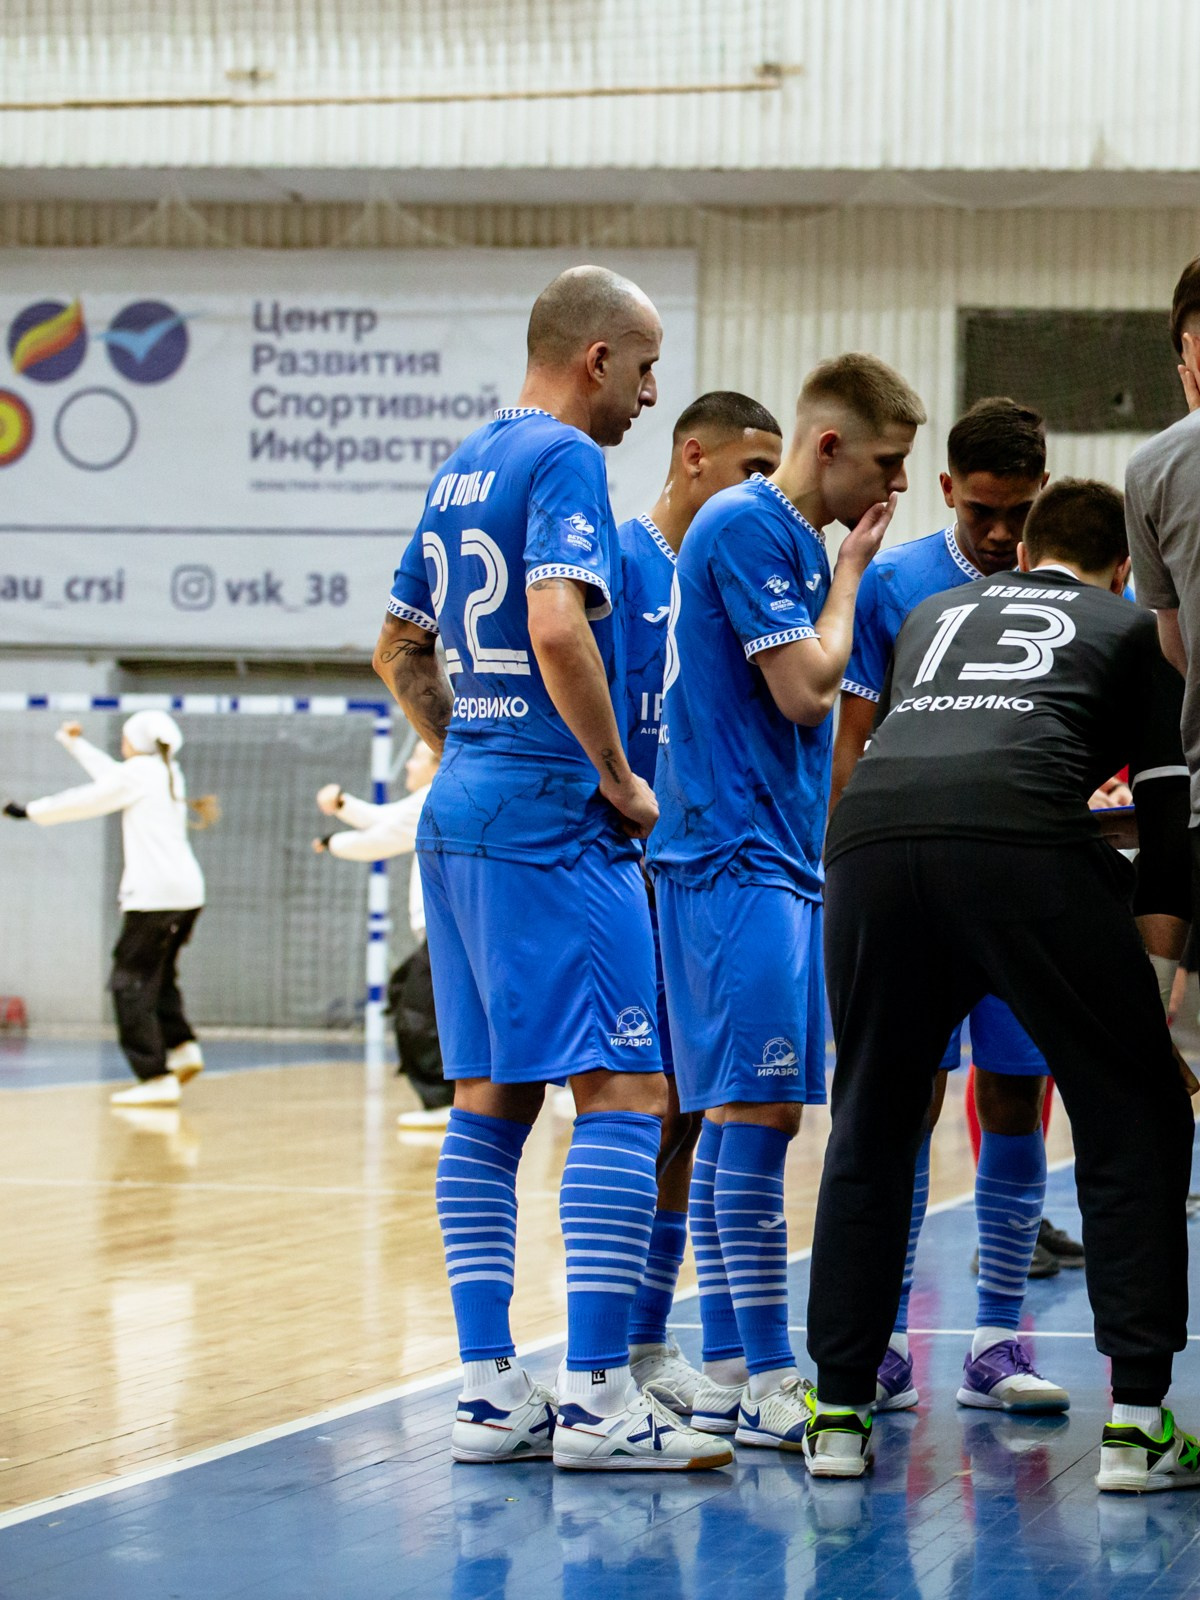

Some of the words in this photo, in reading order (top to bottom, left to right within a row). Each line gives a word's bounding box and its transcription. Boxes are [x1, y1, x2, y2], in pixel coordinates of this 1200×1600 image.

[253, 300, 377, 342] Центр
[253, 344, 440, 376] Развития
[251, 383, 498, 428] Спортивной
[225, 570, 348, 612] vsk_38
[913, 603, 1076, 688] 13
[452, 696, 529, 721] сервико
[897, 695, 1034, 712] сервико
[610, 1037, 653, 1047] ИРАЭРО
[757, 1067, 799, 1077] ИРАЭРО
